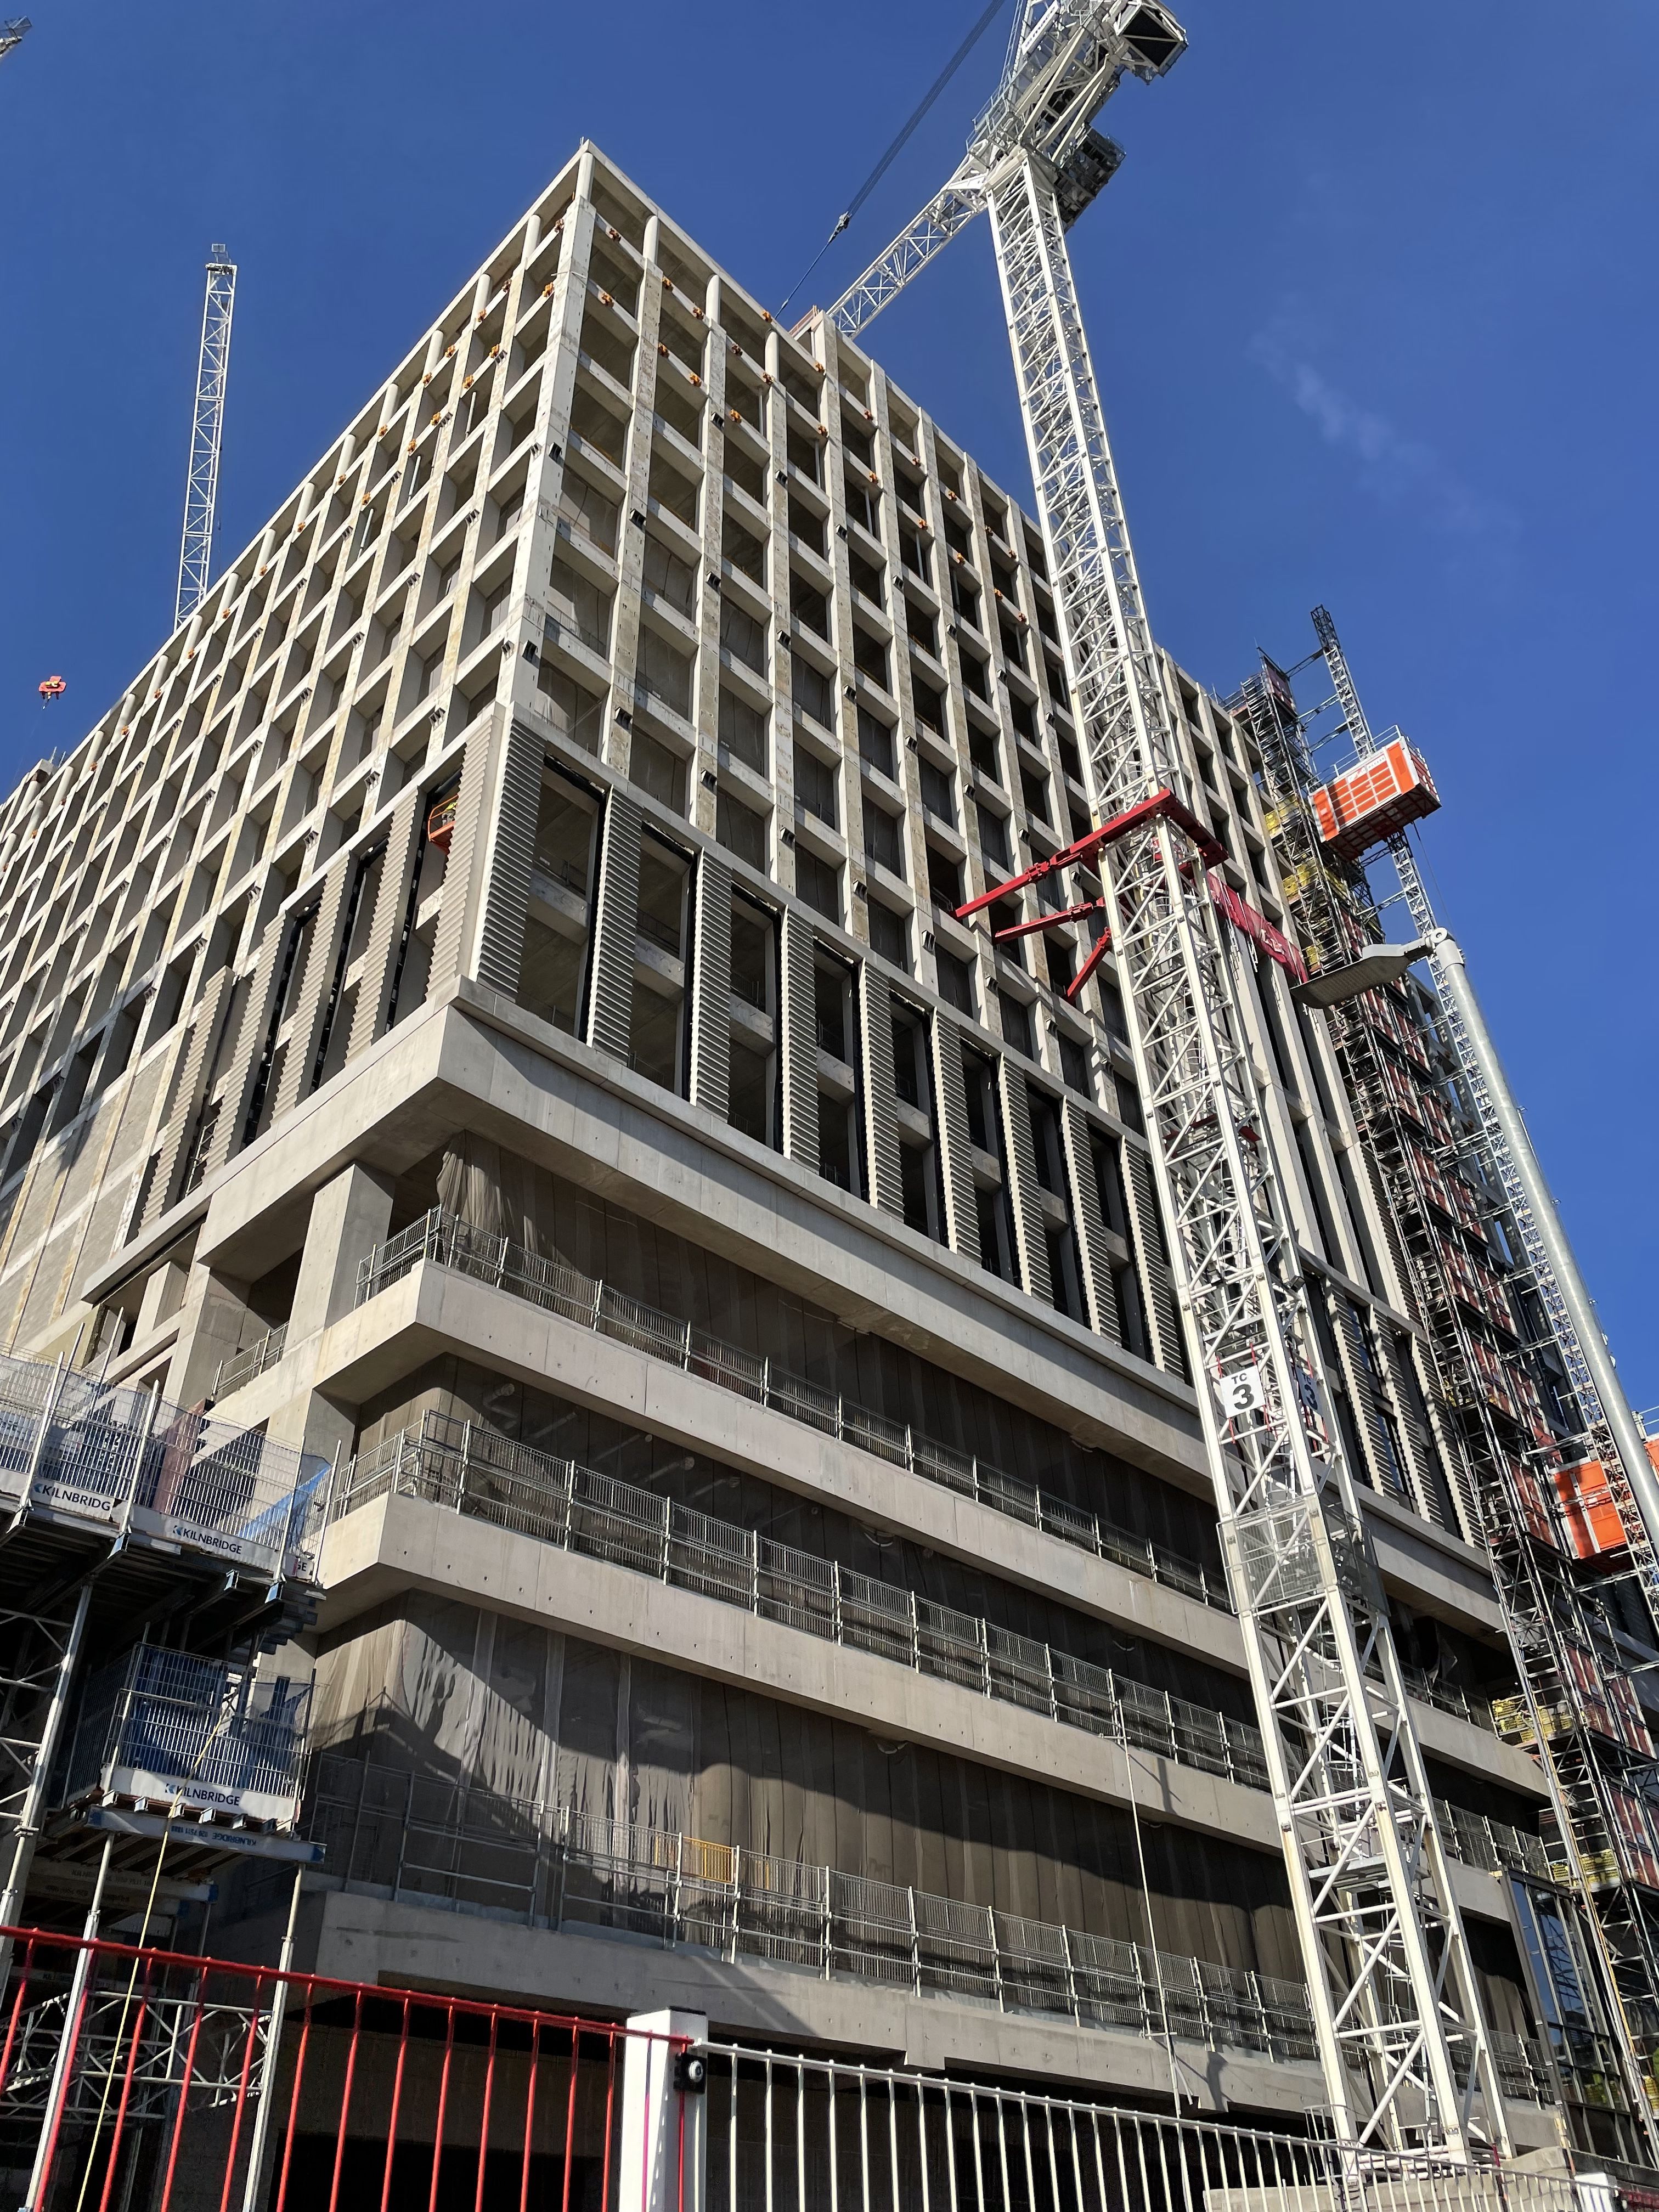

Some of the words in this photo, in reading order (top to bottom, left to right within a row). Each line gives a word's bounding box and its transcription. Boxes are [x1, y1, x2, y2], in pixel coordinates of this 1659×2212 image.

[1231, 1373, 1248, 1384] TC
[1302, 1373, 1312, 1385] TC
[1233, 1384, 1255, 1410] 3
[1304, 1384, 1318, 1410] 3
[42, 1485, 111, 1511] KILNBRIDG
[183, 1528, 242, 1555] KILNBRIDGE
[176, 1785, 240, 1806] KILNBRIDGE
[212, 1832, 257, 1846] KILNBRIDGE
